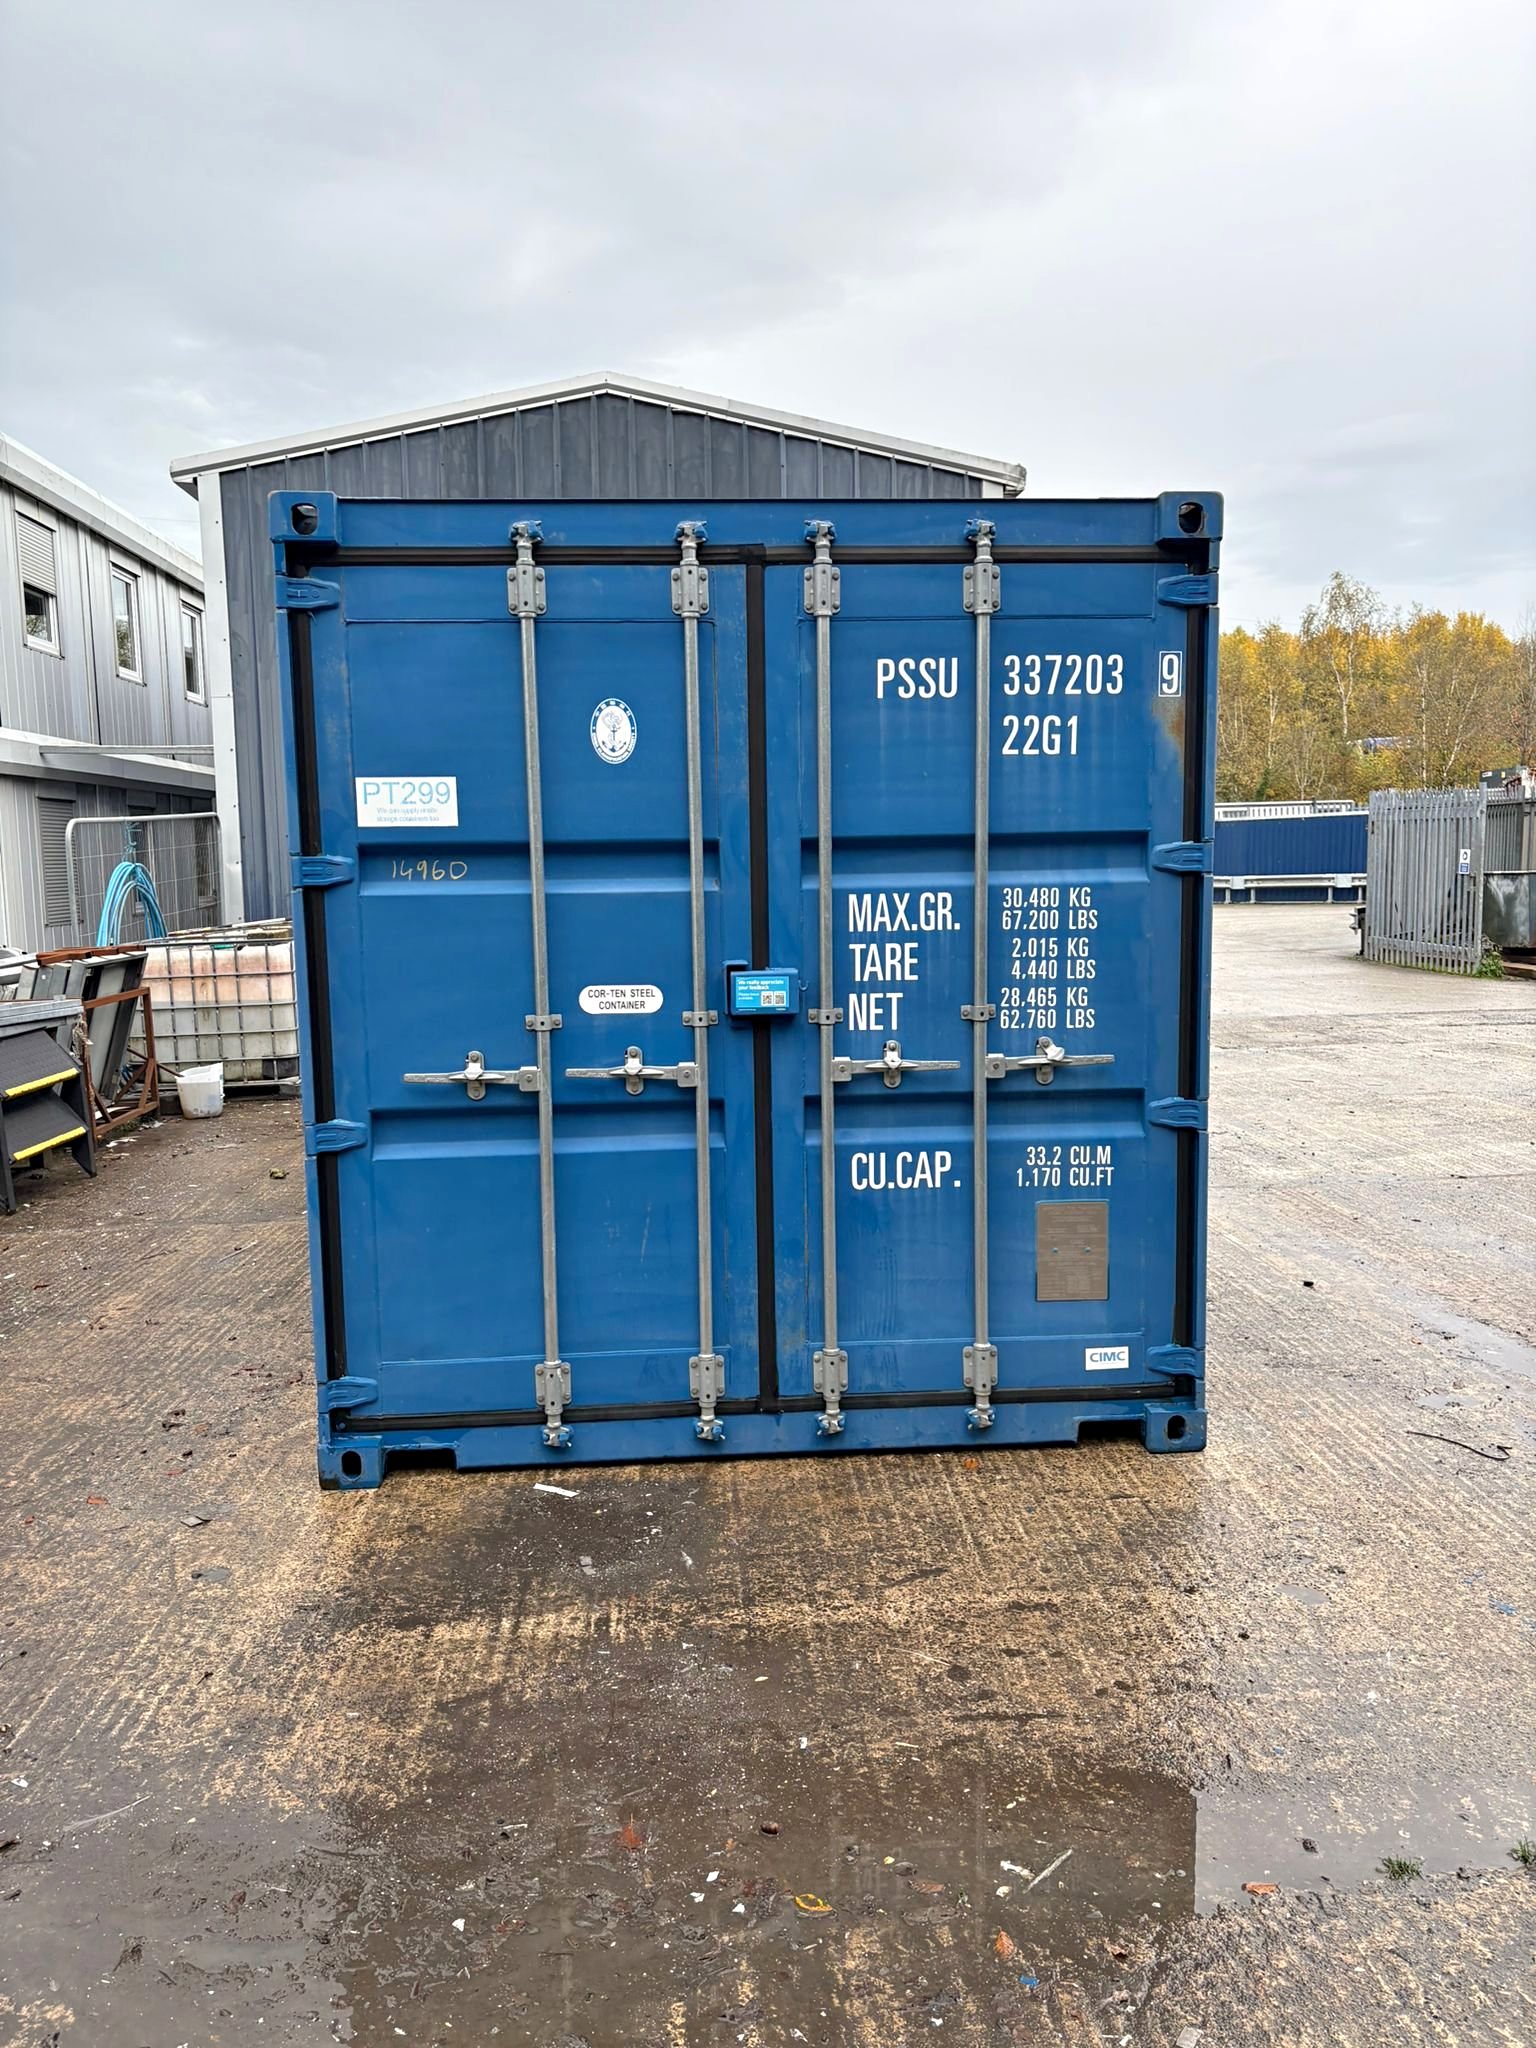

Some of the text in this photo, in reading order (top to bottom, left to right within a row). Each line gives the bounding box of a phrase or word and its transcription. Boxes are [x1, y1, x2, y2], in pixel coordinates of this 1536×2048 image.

[876, 654, 1180, 699] PSSU 337203 9
[1002, 714, 1079, 755] 22G1
[363, 782, 450, 805] PT299
[392, 860, 468, 881] 14960
[1002, 887, 1091, 908] 30,480 KG
[848, 891, 961, 933] MAX.GR.
[1002, 910, 1098, 930] 67,200 LBS
[1011, 938, 1089, 958] 2,015 KG
[848, 942, 919, 982] TARE
[1011, 960, 1096, 980] 4,440 LBS
[588, 989, 655, 998] COR-TEN STEEL
[1000, 987, 1088, 1008] 28,465 KG
[599, 1001, 646, 1010] CONTAINER
[848, 992, 904, 1031] NET
[1000, 1009, 1095, 1029] 62,760 LBS
[1026, 1146, 1111, 1166] 33.2 CU.M
[851, 1151, 961, 1191] CU.CAP.
[1016, 1167, 1114, 1187] 1,170 CU.FT
[1090, 1351, 1126, 1362] CIMC
